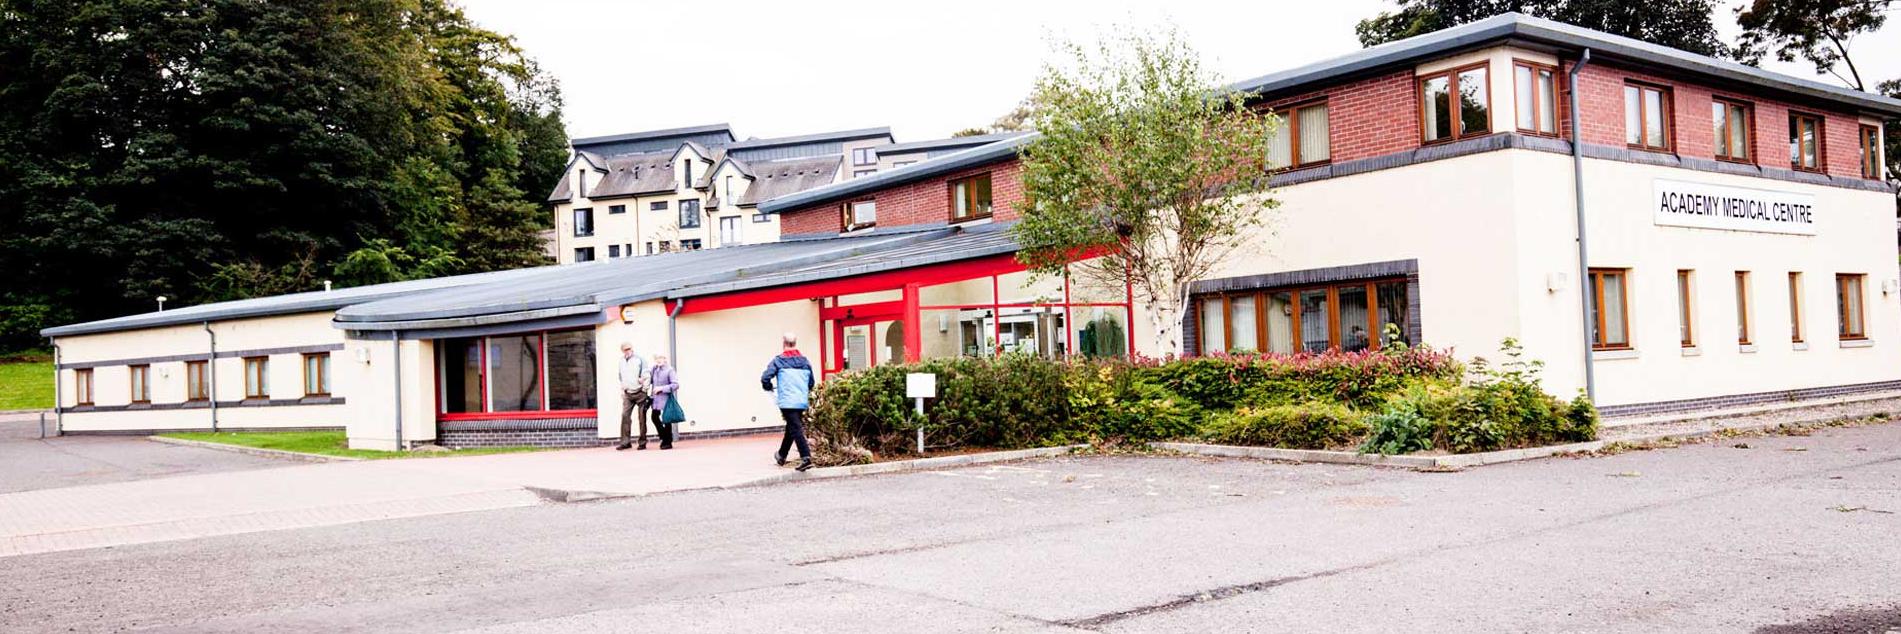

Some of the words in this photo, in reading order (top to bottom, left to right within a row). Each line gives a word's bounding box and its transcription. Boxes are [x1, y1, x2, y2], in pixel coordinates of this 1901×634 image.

[1661, 191, 1719, 216] ACADEMY
[1723, 197, 1771, 221] MEDICAL
[1772, 202, 1813, 224] CENTRE
